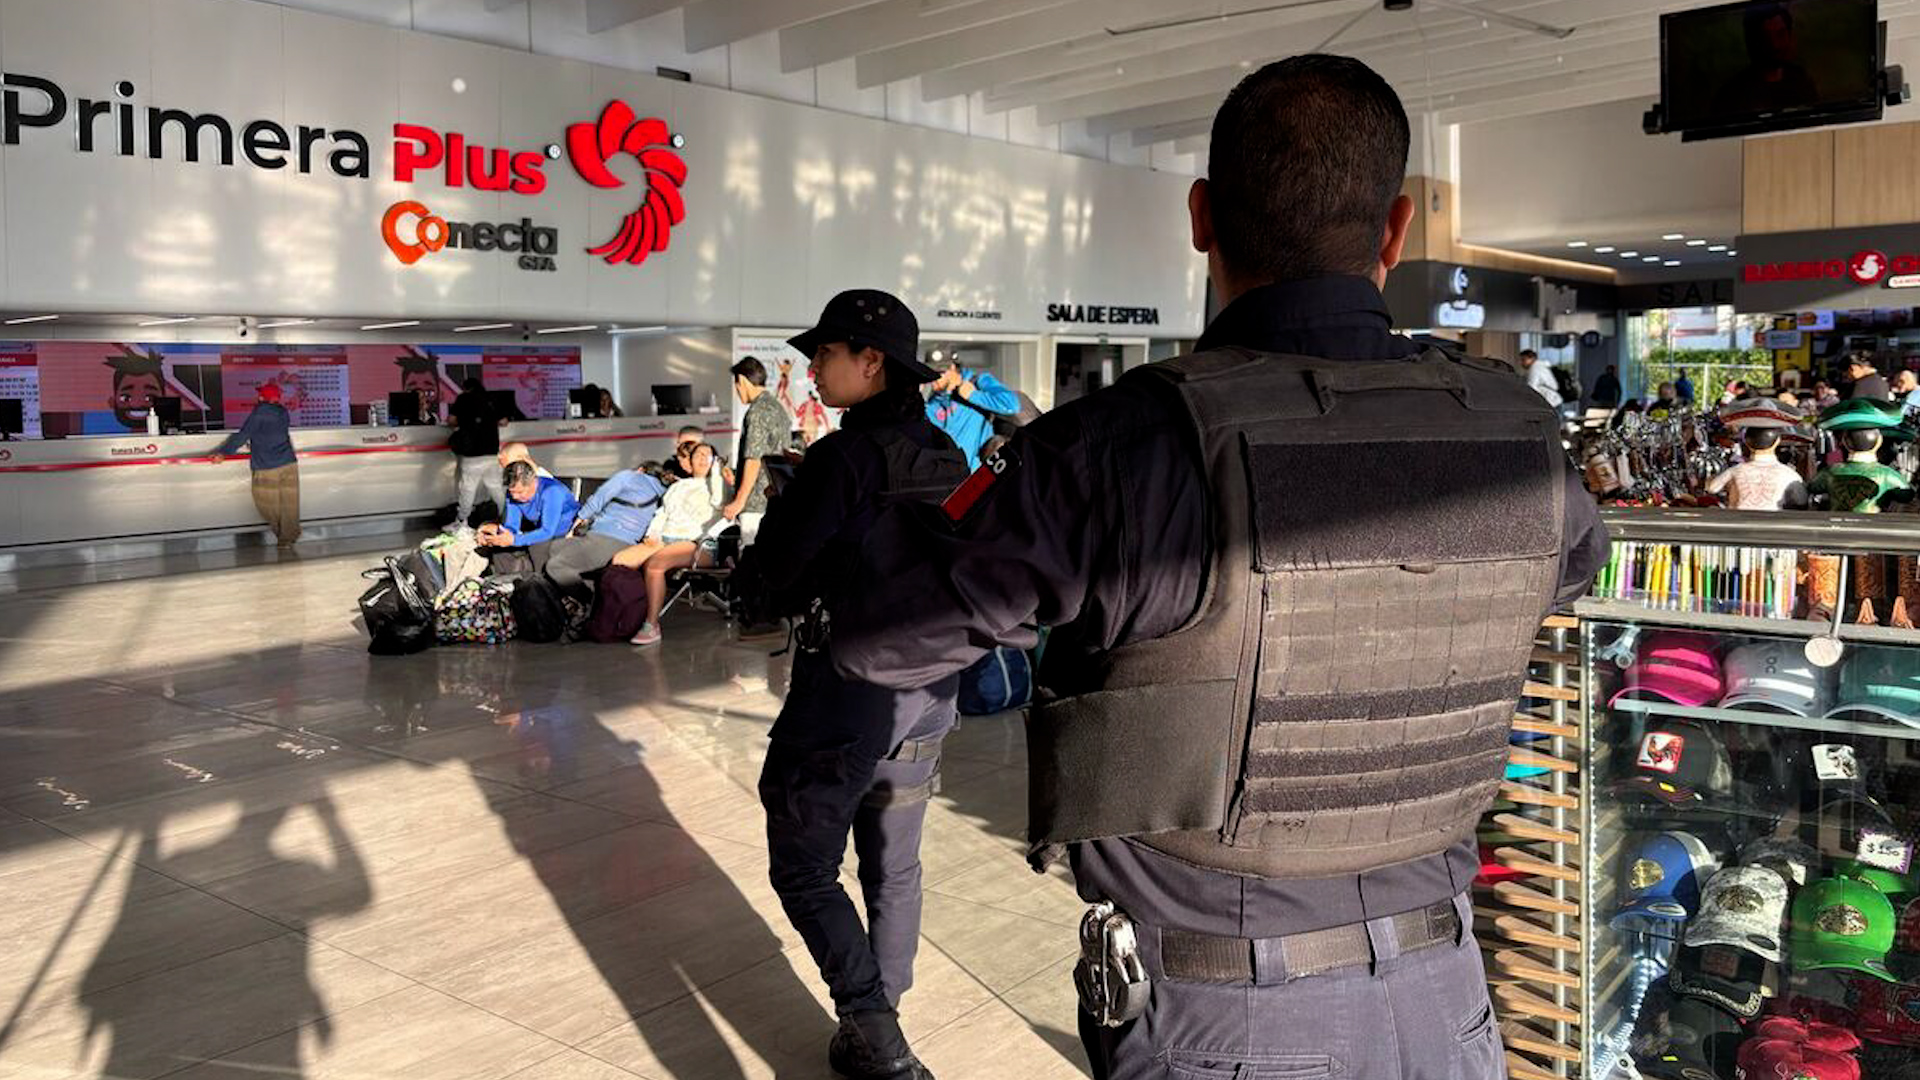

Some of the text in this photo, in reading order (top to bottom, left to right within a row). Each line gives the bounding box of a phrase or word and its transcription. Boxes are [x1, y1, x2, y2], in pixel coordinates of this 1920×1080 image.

[1, 73, 547, 195] Primera Plus
[381, 200, 558, 265] Conecta
[1046, 303, 1160, 325] SALA DE ESPERA
